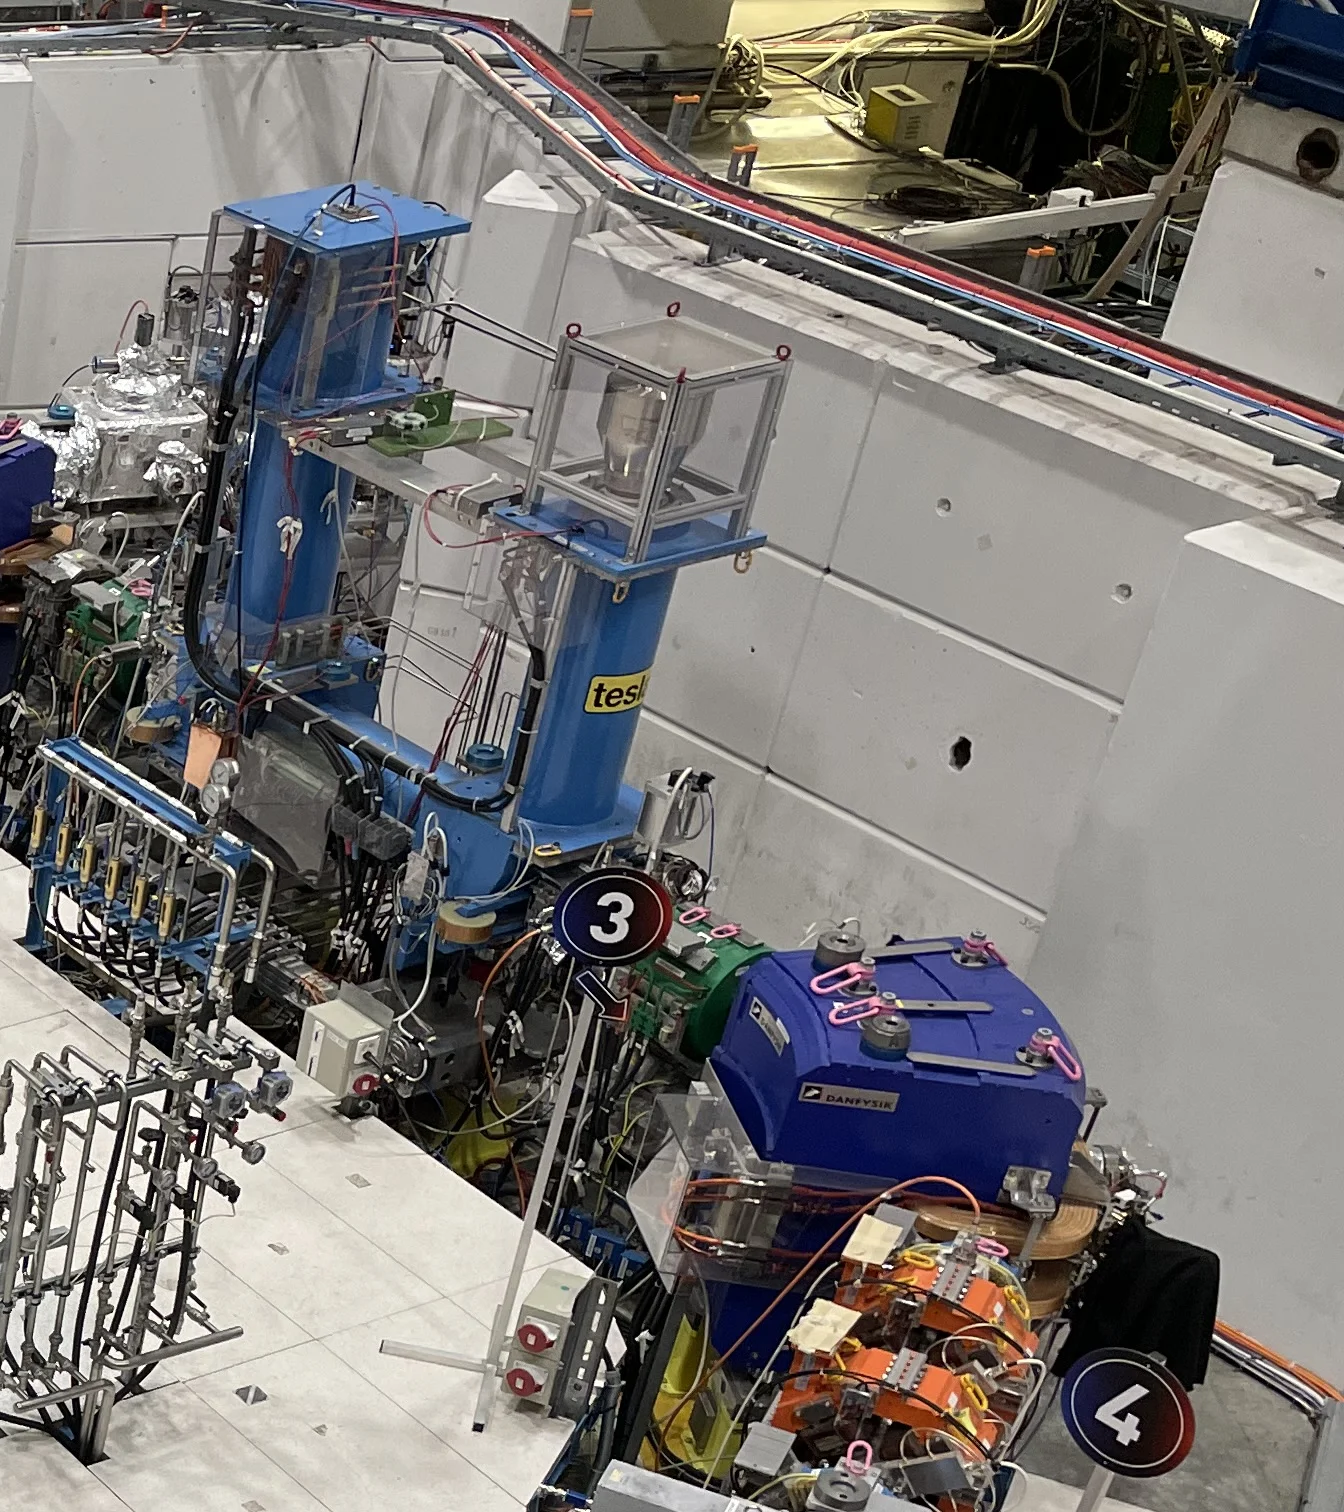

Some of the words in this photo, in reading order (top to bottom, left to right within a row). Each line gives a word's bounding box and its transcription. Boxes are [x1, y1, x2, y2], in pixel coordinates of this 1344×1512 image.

[588, 891, 635, 945] 3
[826, 1093, 893, 1110] DANFYSIK
[1093, 1383, 1150, 1447] 4
